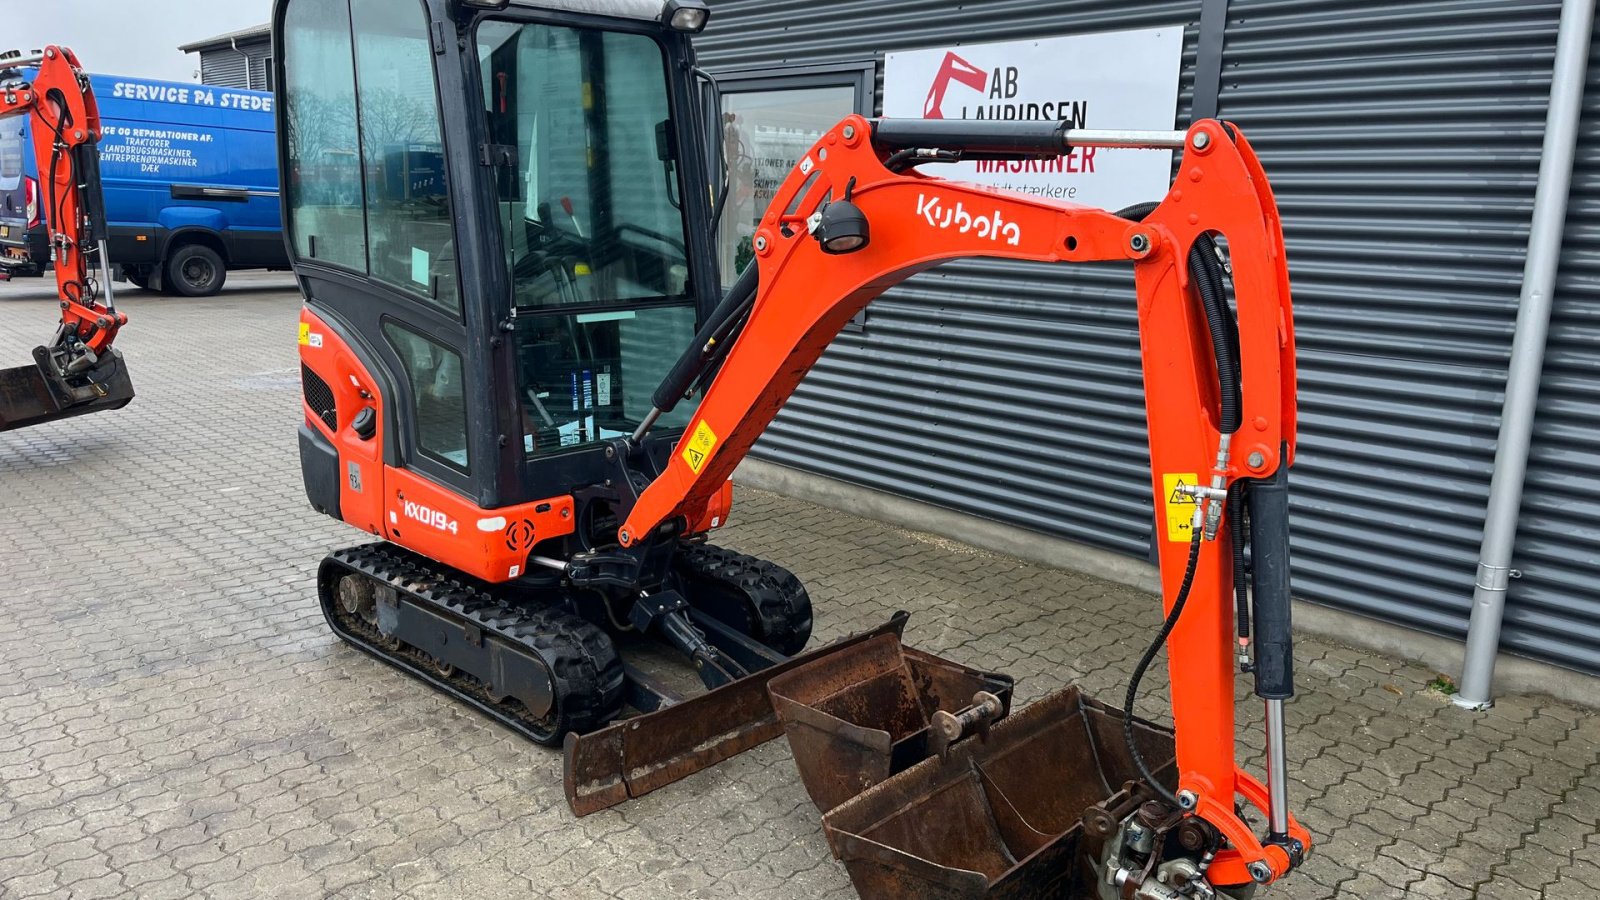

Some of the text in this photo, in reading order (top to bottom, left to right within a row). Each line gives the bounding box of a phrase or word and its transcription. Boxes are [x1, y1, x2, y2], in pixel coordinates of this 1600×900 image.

[989, 66, 1018, 99] AB
[113, 82, 275, 112] SERVICE PÅ STEDE
[118, 127, 130, 136] OG
[133, 128, 199, 141] REPARATIONER
[200, 134, 214, 143] AF:
[125, 137, 170, 148] TRAKTORER
[105, 144, 192, 158] LANDBRUGSMASKINER
[100, 152, 198, 167] ENTREPRENØRMASKINER
[141, 163, 160, 173] DÆK
[917, 193, 1021, 246] Kubota
[404, 500, 458, 535] KX019-4
